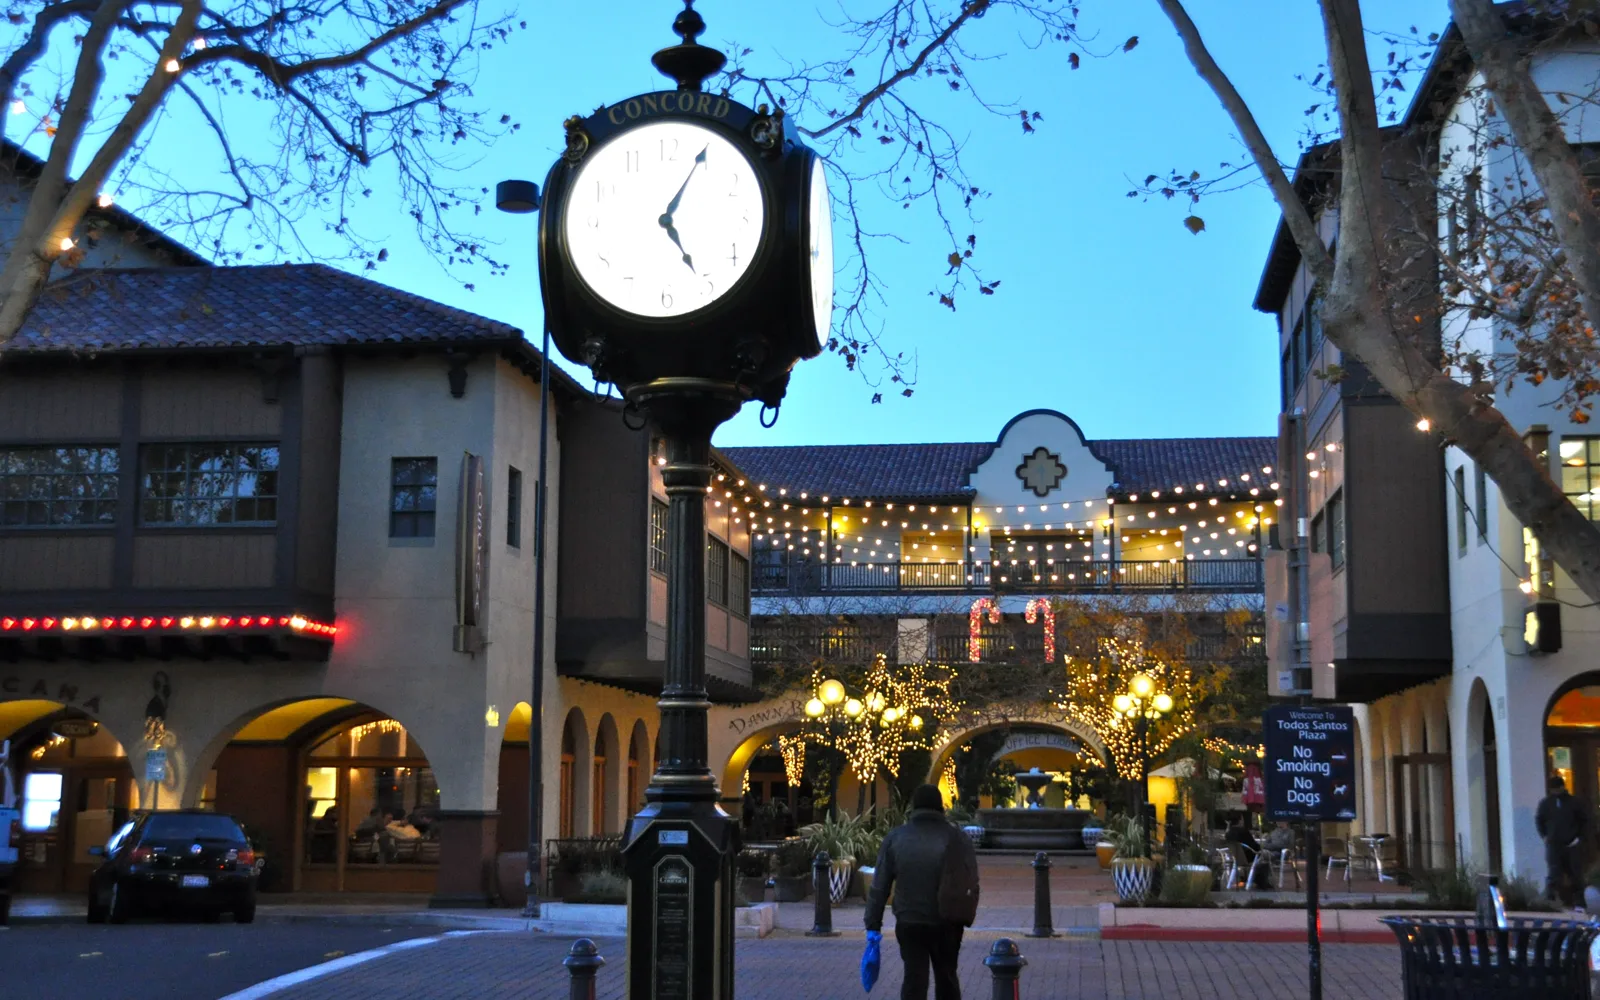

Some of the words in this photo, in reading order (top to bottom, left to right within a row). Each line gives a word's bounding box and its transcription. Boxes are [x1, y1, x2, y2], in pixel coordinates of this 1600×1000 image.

[607, 92, 730, 125] CONCORD
[659, 138, 679, 162] 12
[626, 150, 639, 173] 11
[728, 173, 739, 197] 2
[700, 271, 714, 296] 5
[660, 283, 674, 309] 6
[474, 472, 483, 609] TOSCANA
[728, 705, 782, 735] DAWN
[1277, 720, 1309, 730] Todos
[1312, 720, 1348, 730] Santos
[1289, 711, 1324, 720] Welcome
[1325, 711, 1335, 720] To
[1005, 734, 1040, 751] OFFICE
[1298, 730, 1327, 740] Plaza
[1293, 745, 1313, 758] No
[1276, 758, 1330, 777] Smoking
[1293, 776, 1313, 789] No
[1287, 790, 1321, 806] Dogs
